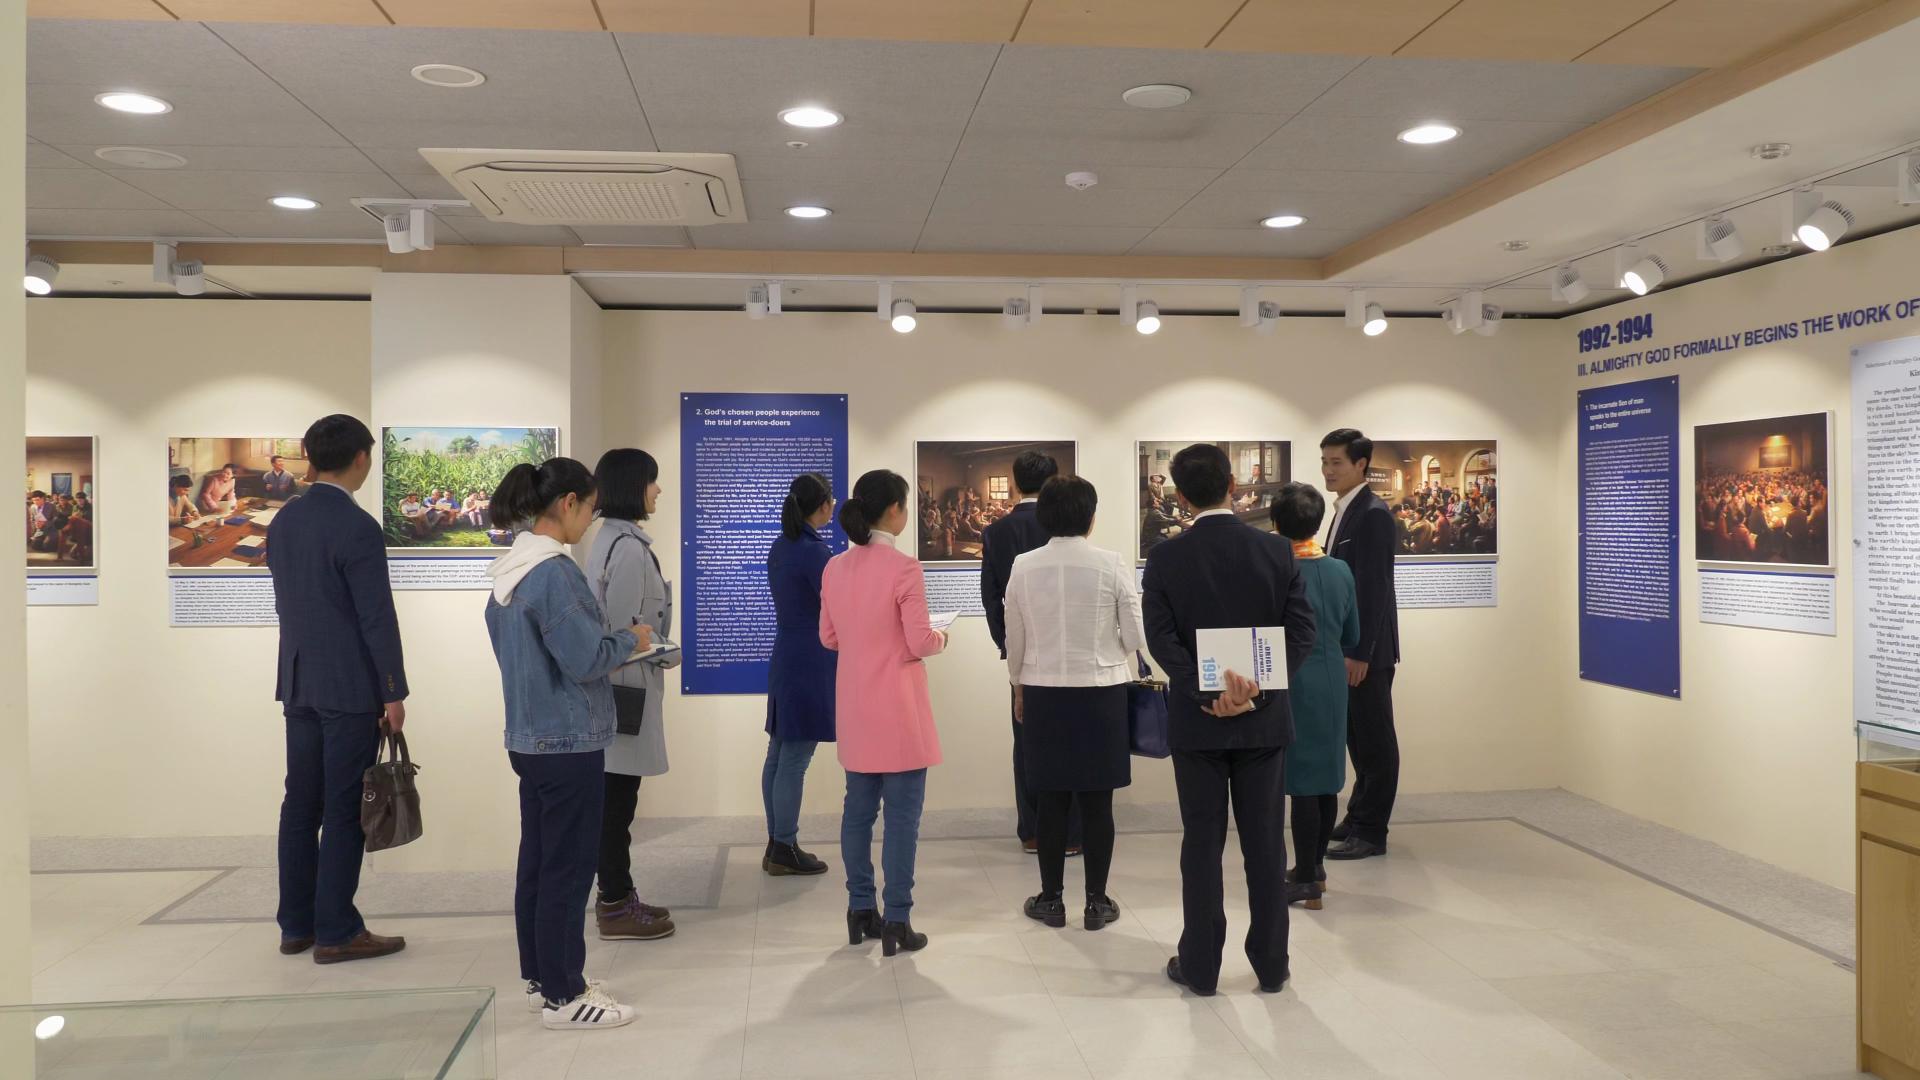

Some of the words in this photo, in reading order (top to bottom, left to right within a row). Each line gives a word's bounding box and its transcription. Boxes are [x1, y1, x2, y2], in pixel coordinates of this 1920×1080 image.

[1577, 313, 1653, 352] 1992-1994
[1577, 364, 1588, 376] III.
[1590, 353, 1642, 375] ALMIGHTY
[1646, 348, 1670, 364] GOD
[1674, 334, 1740, 359] FORMALLY
[1744, 323, 1798, 346] BEGINS
[1802, 315, 1833, 335] THE
[1838, 305, 1890, 328] WORK
[1202, 657, 1218, 688] 1991
